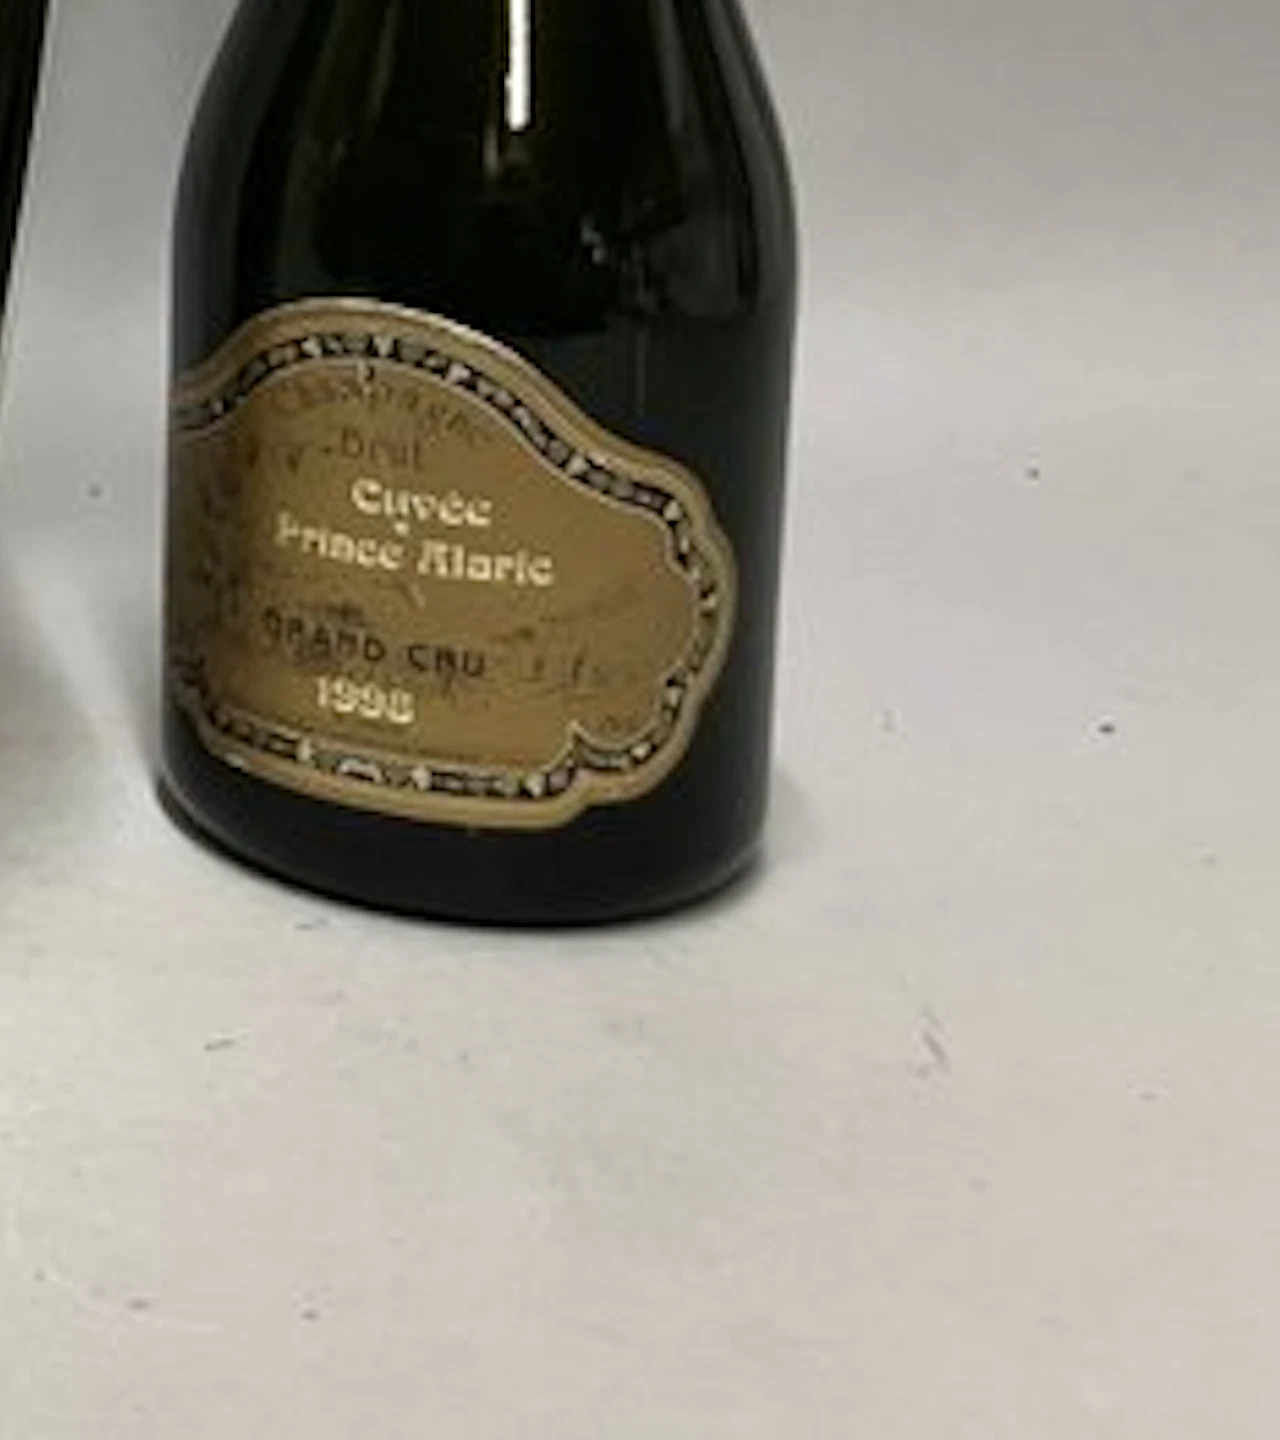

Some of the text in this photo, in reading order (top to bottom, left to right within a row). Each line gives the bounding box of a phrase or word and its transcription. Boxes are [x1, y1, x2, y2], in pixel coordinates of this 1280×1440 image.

[276, 512, 405, 571] Prince
[262, 605, 486, 678] GRAND CRU
